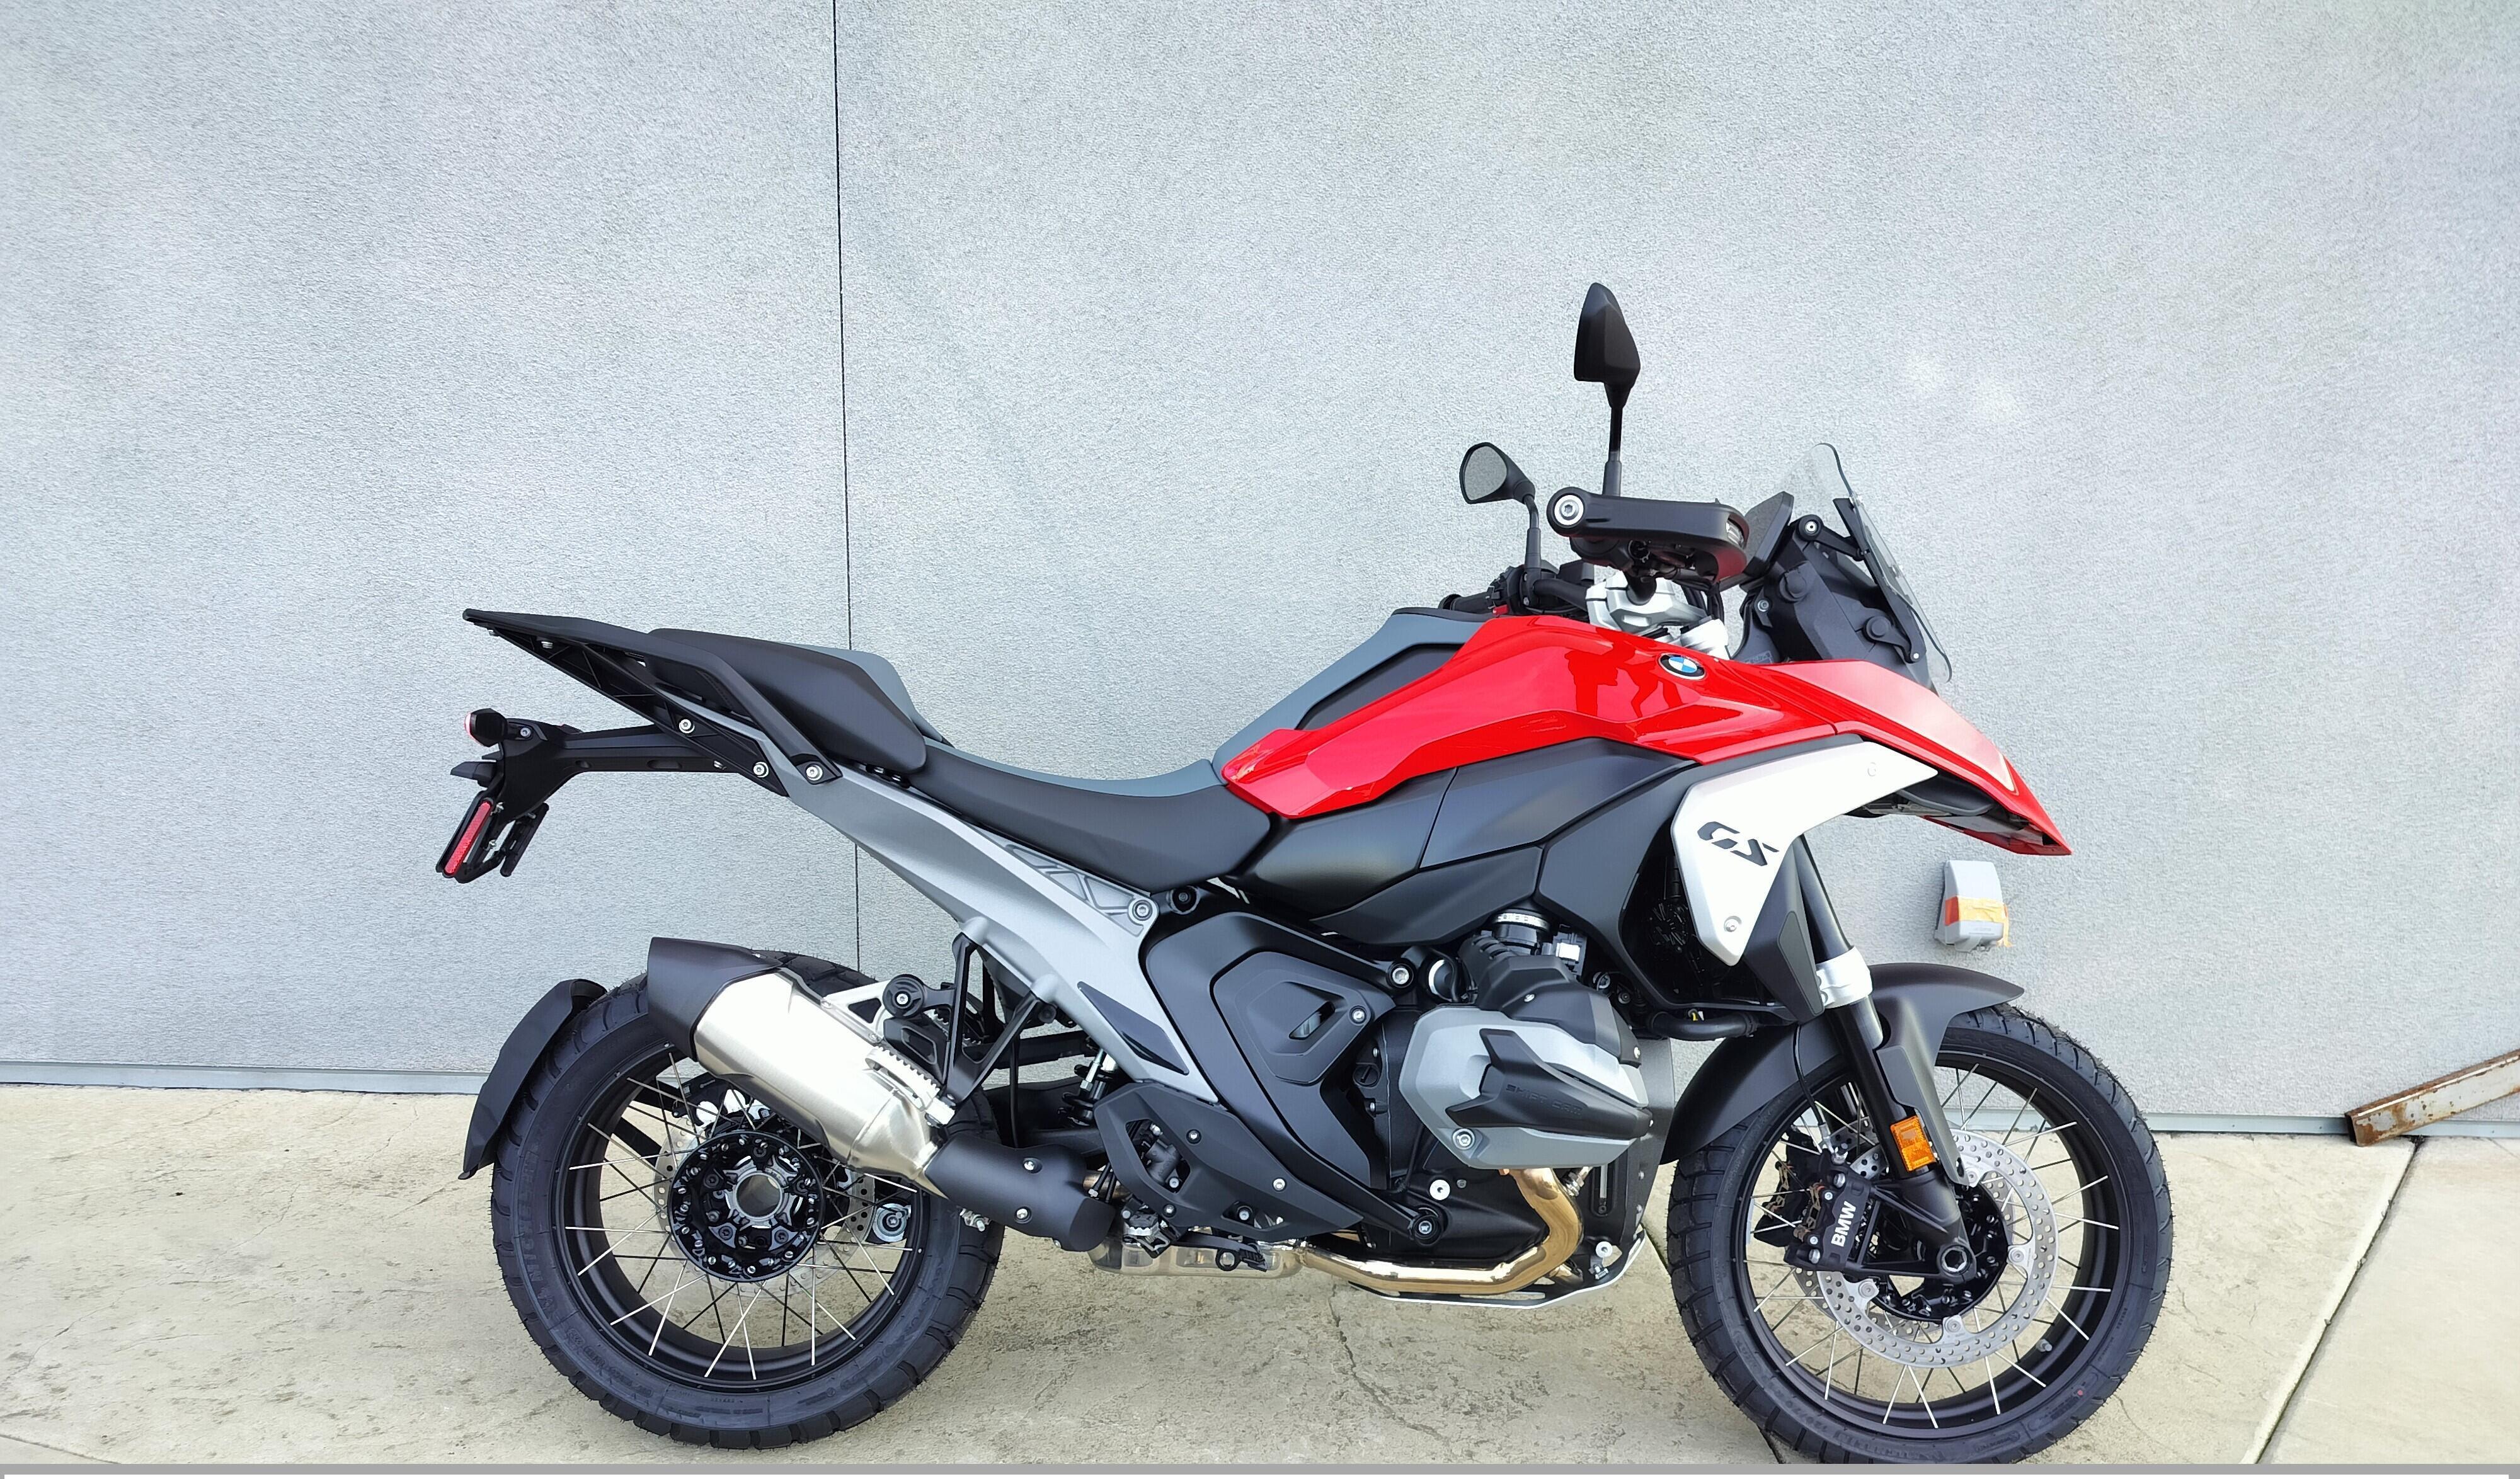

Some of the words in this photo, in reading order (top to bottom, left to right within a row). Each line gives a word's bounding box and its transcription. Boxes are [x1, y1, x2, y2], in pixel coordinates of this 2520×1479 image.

[1697, 821, 1780, 867] GS
[1506, 1083, 1548, 1104] SHIFT
[1831, 1201, 1857, 1247] BMW
